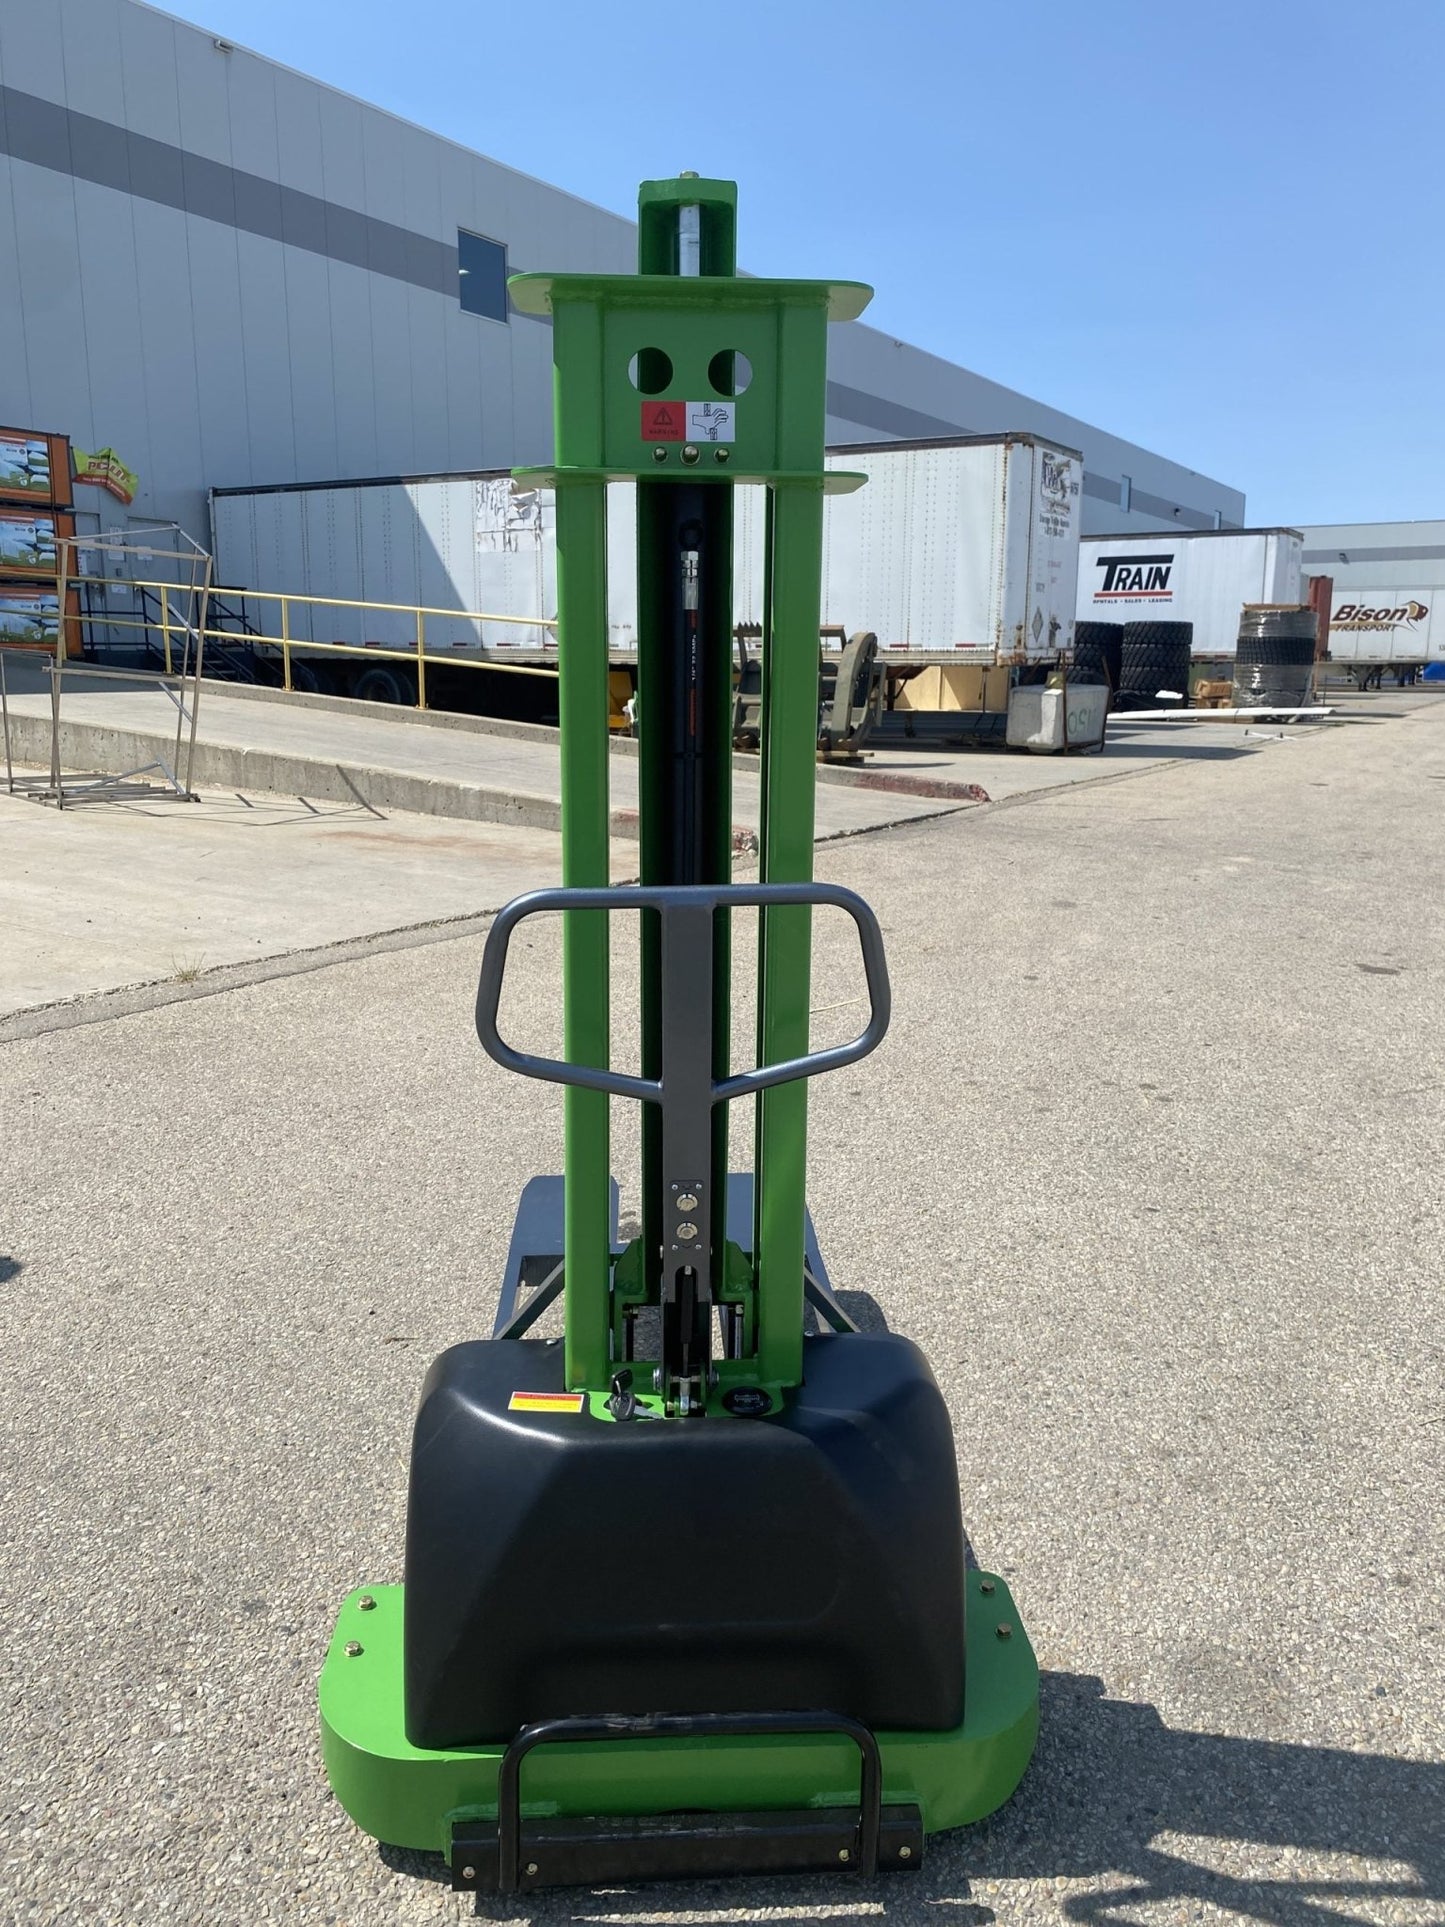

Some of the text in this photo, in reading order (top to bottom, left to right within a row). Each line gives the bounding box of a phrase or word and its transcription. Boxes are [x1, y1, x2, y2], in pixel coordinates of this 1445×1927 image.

[1096, 554, 1175, 591] TRAIN
[1332, 603, 1409, 621] Bison
[1335, 623, 1398, 632] TRANSPORT
